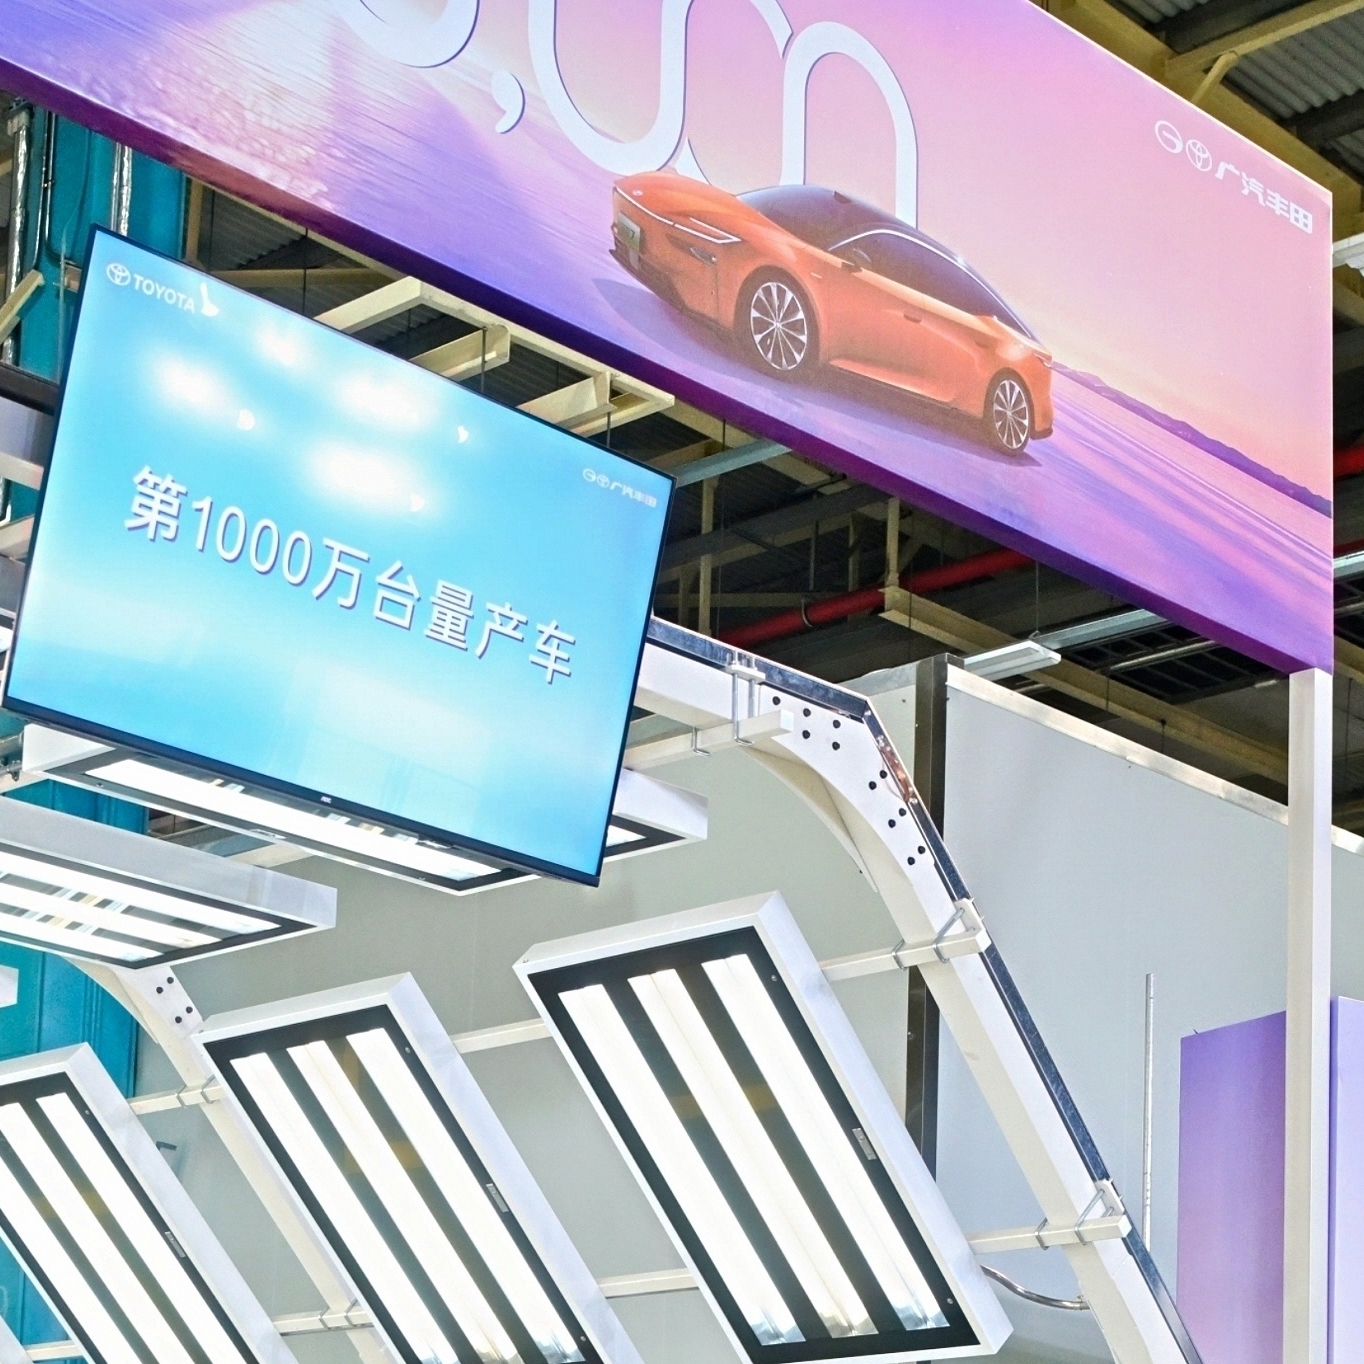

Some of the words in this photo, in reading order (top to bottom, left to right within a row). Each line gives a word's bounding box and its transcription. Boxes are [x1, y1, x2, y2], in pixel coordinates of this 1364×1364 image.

[1215, 161, 1313, 234] 广汽丰田
[133, 273, 196, 314] TOYOTA
[124, 464, 576, 686] 第1000万台量产车
